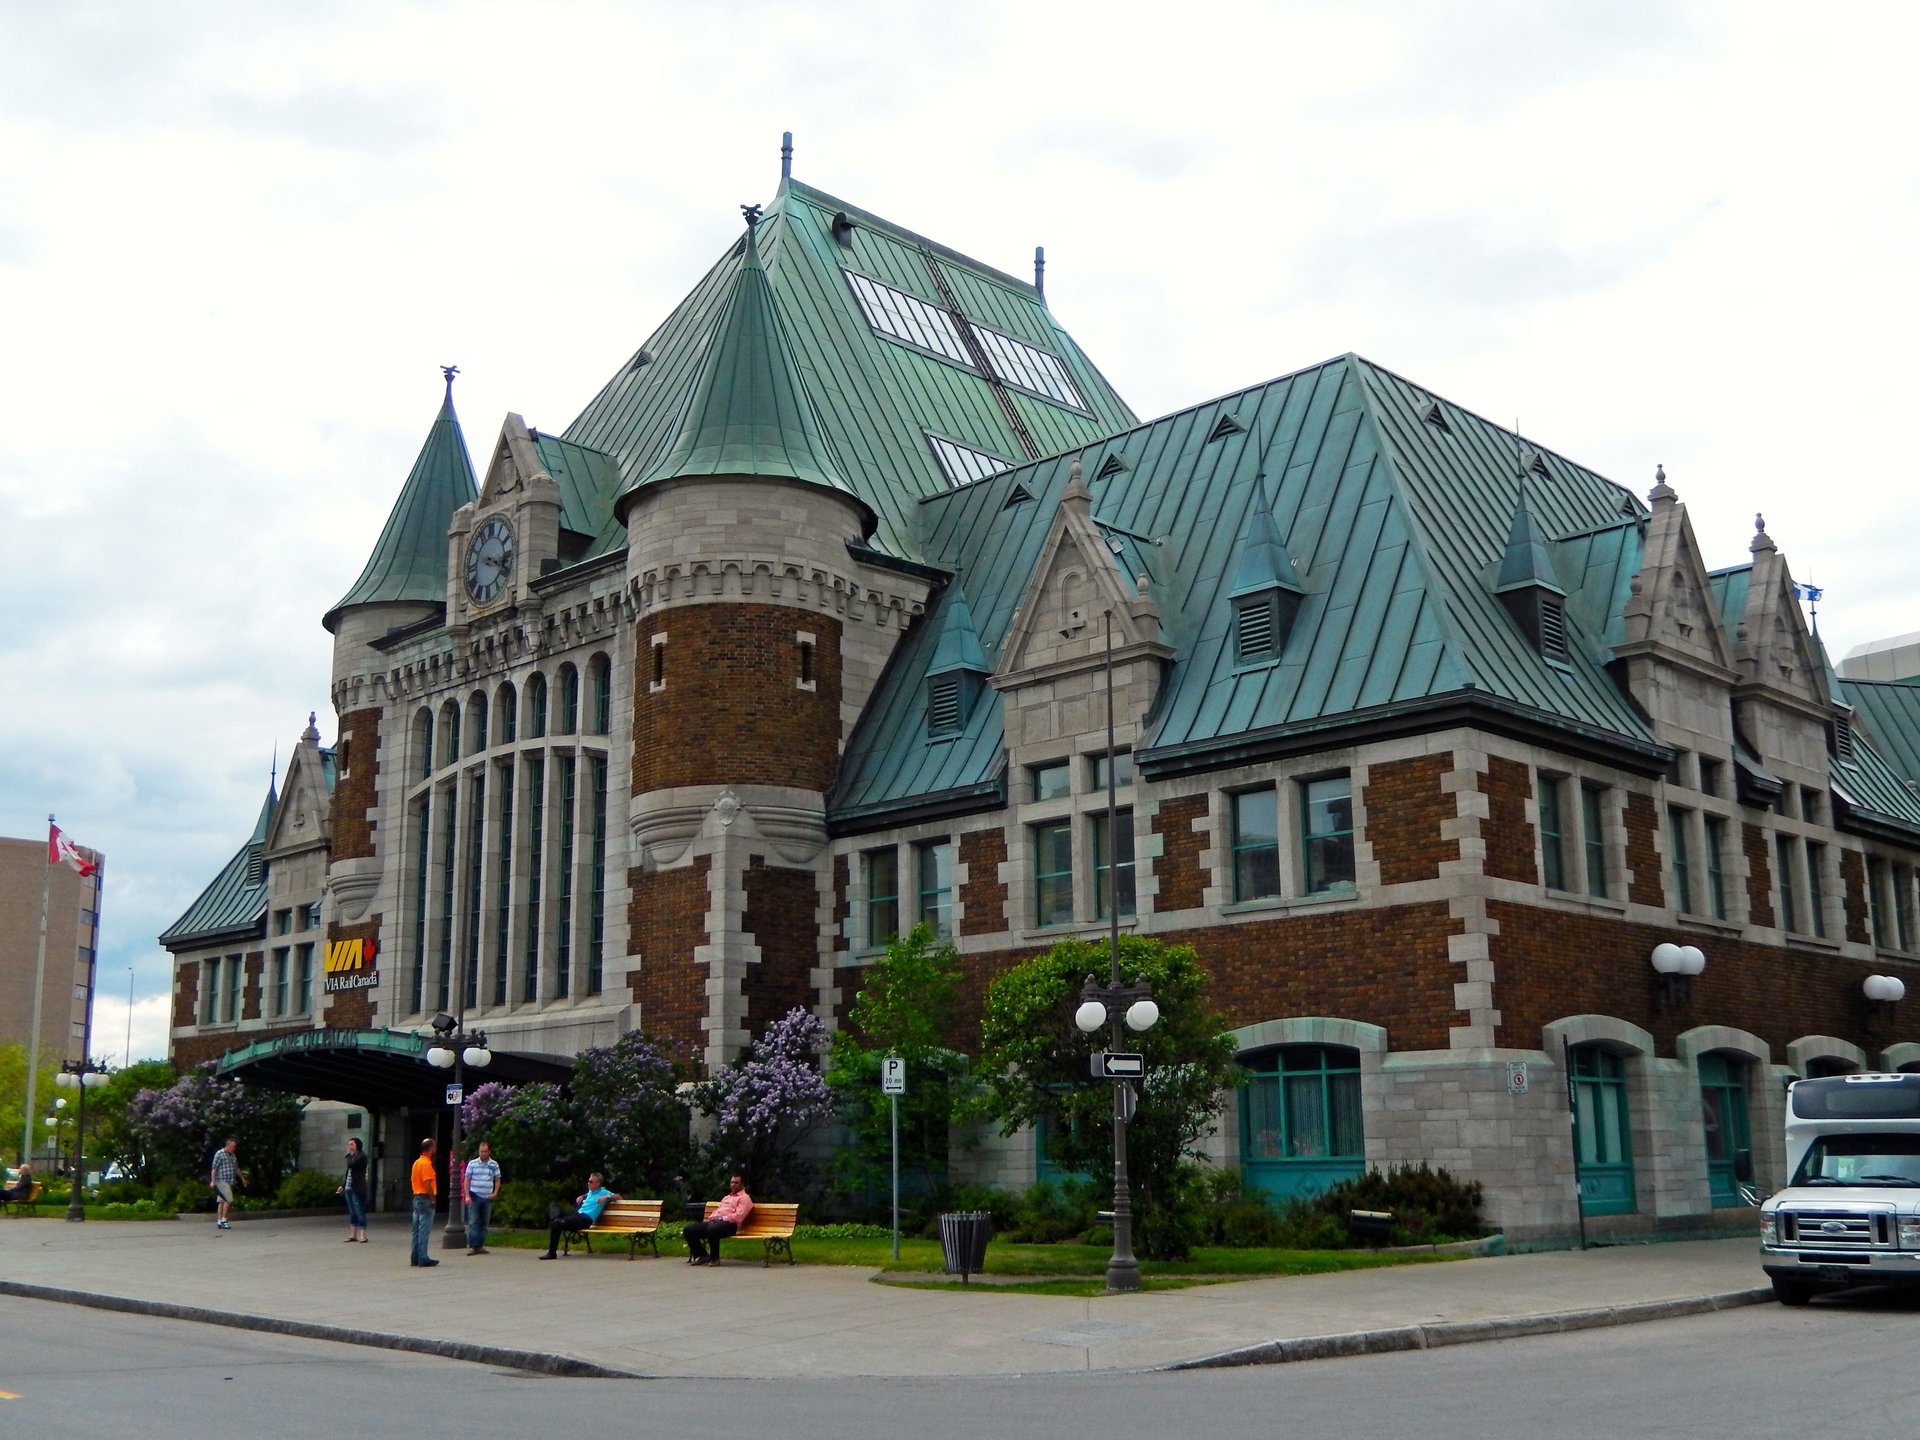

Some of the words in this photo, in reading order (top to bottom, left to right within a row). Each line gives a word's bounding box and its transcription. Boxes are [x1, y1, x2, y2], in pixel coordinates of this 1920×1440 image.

[324, 938, 363, 972] VIA
[326, 978, 339, 990] VIA
[340, 975, 353, 989] Rail
[353, 972, 377, 988] Canada
[272, 1034, 299, 1052] GARE
[324, 1029, 358, 1048] PALAIS
[890, 1061, 898, 1075] P
